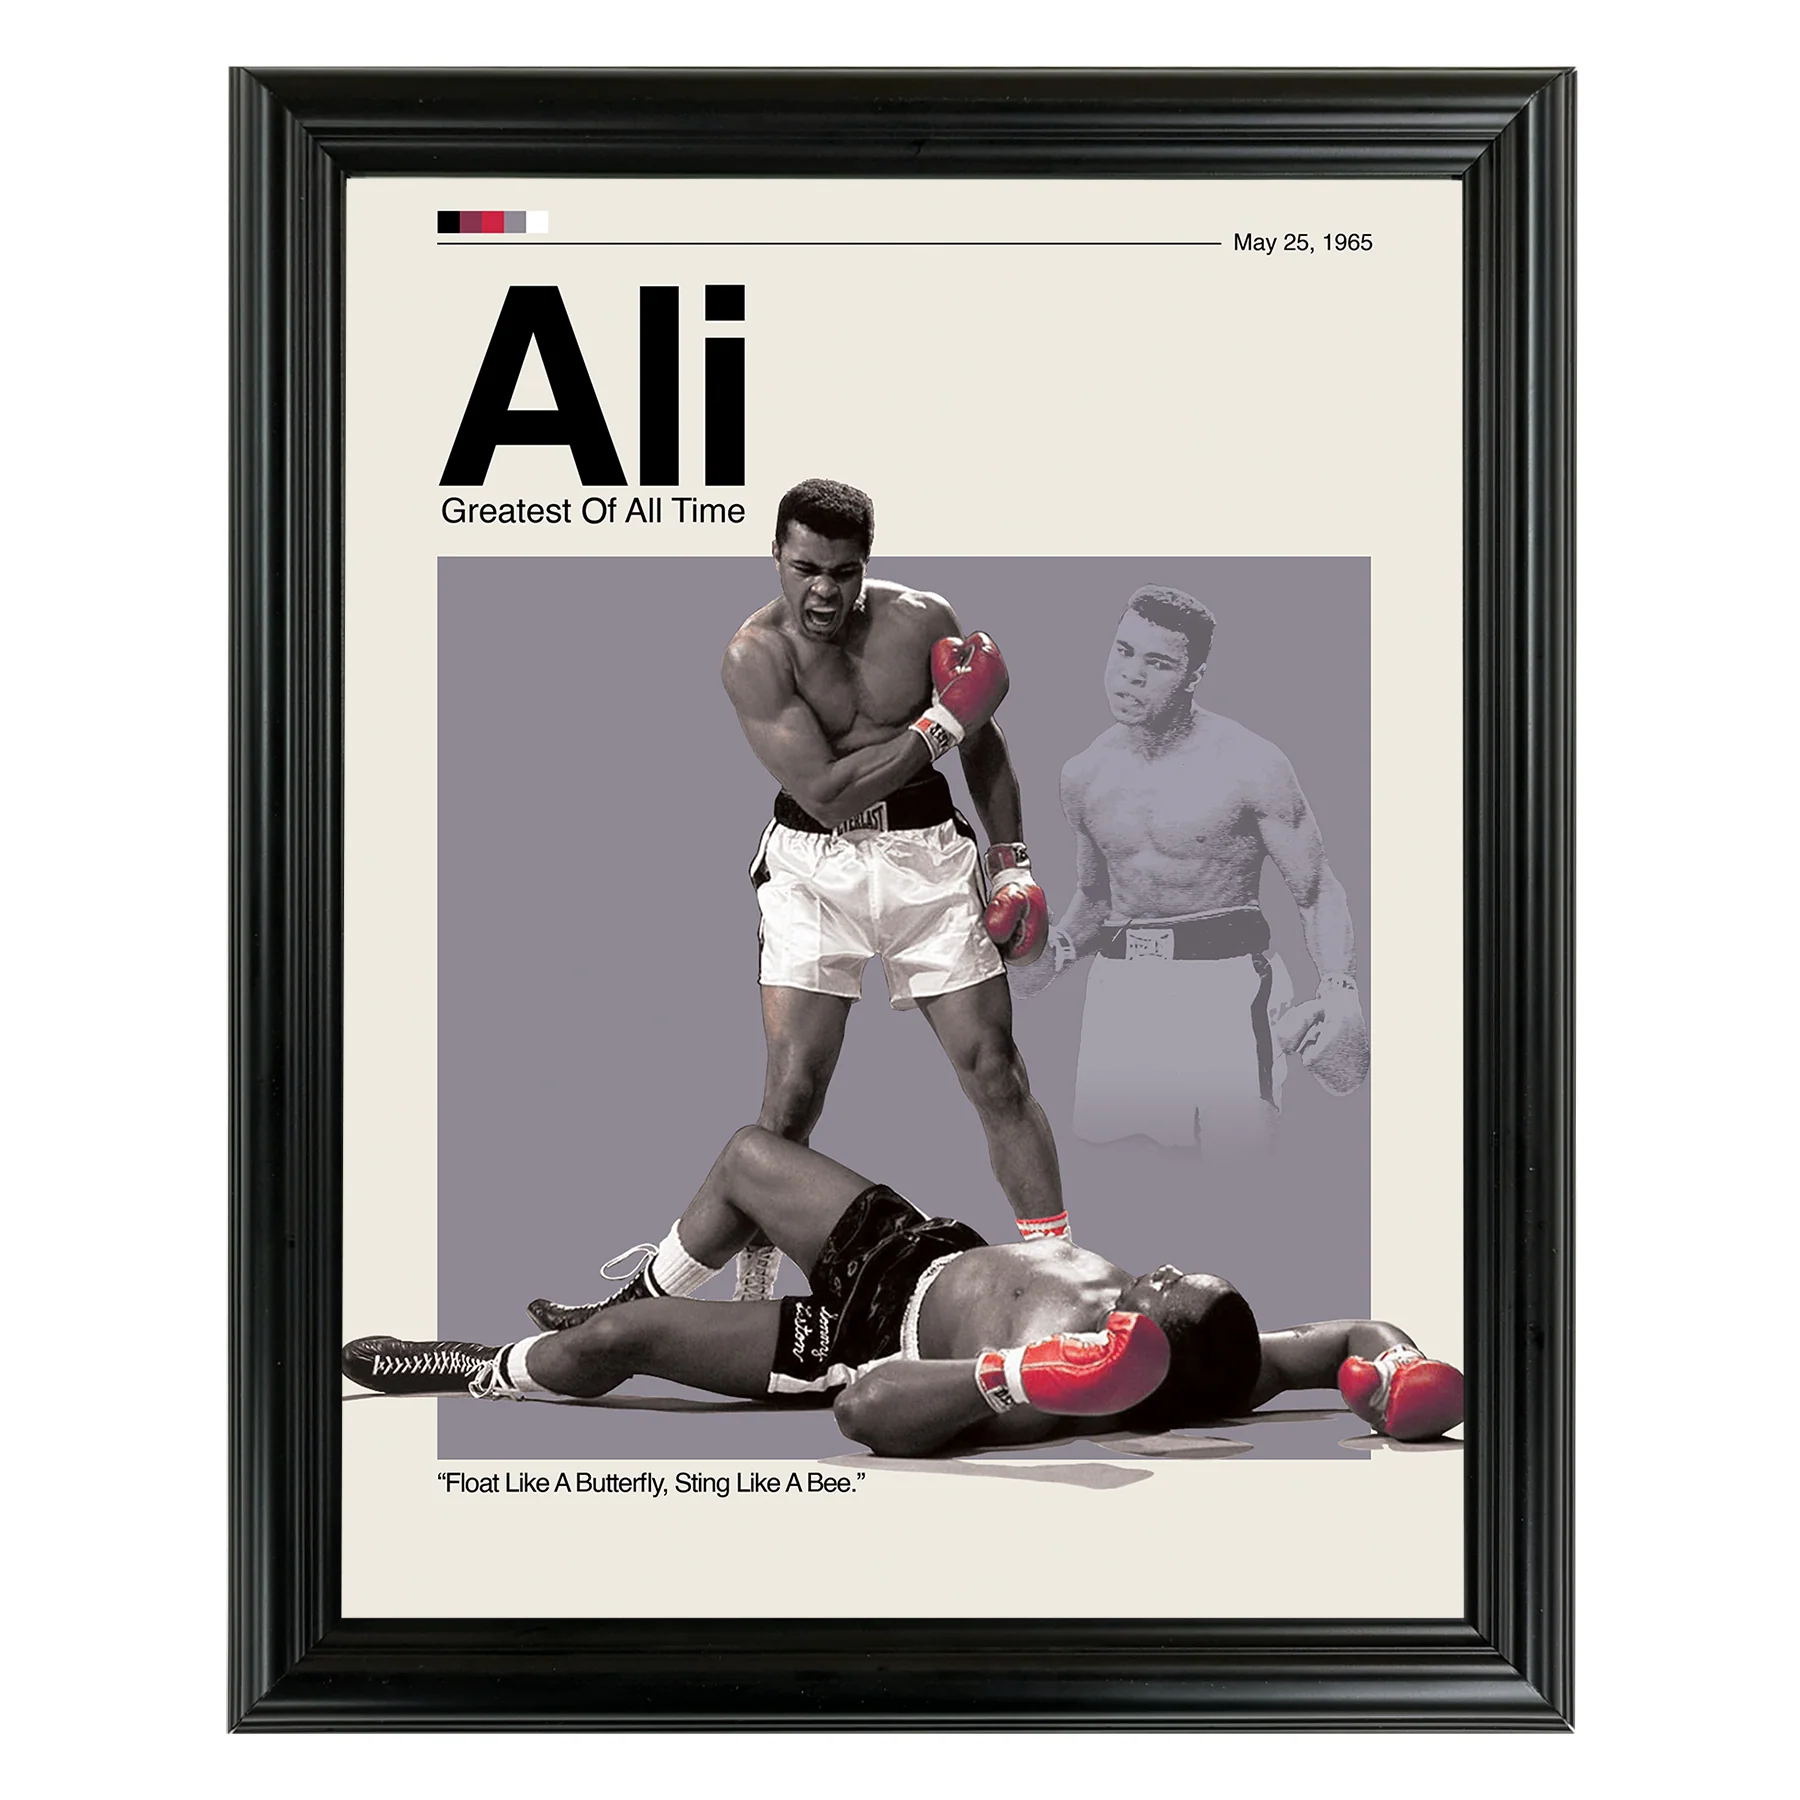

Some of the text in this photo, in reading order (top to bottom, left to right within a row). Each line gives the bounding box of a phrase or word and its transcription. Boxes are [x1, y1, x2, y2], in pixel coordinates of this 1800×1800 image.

[1234, 232, 1373, 256] May 25, 1965
[438, 284, 746, 487] Ali
[441, 496, 746, 525] Greatest Of All Time
[437, 1471, 866, 1498] “Float Like A Butterfly, Sting Like A Bee.”
